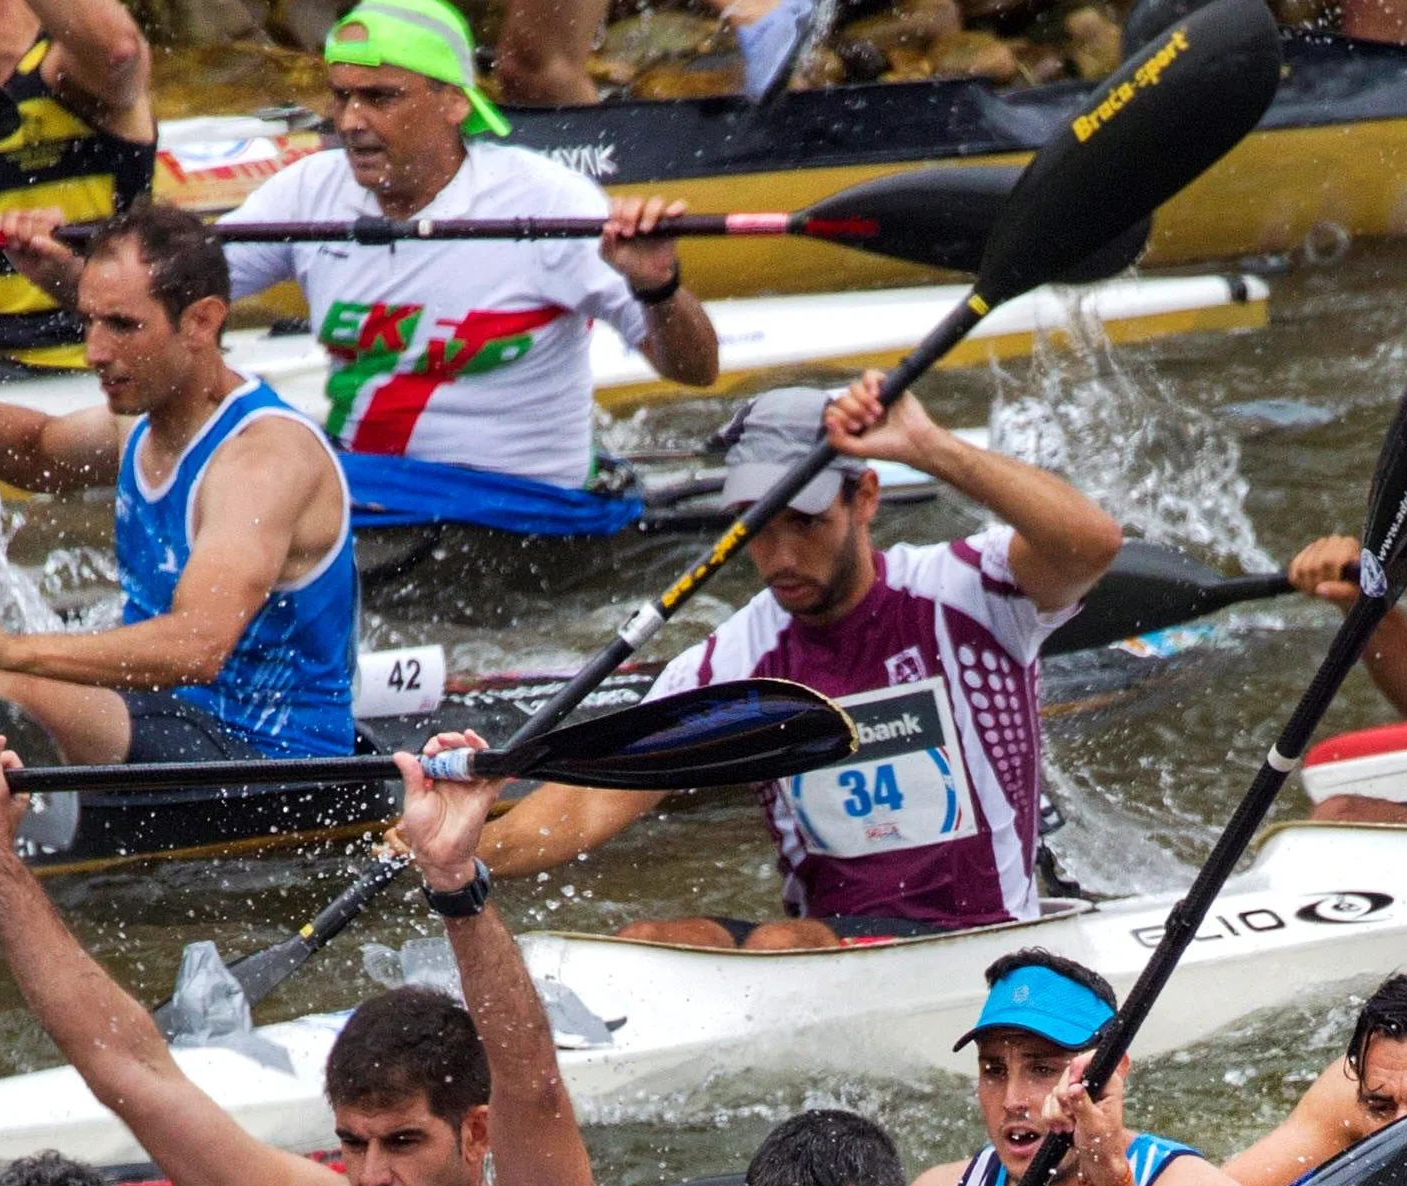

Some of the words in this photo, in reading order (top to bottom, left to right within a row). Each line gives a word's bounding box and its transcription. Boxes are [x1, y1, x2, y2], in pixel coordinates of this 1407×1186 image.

[388, 659, 423, 692] 42
[852, 713, 921, 745] bank
[837, 764, 903, 818] 34
